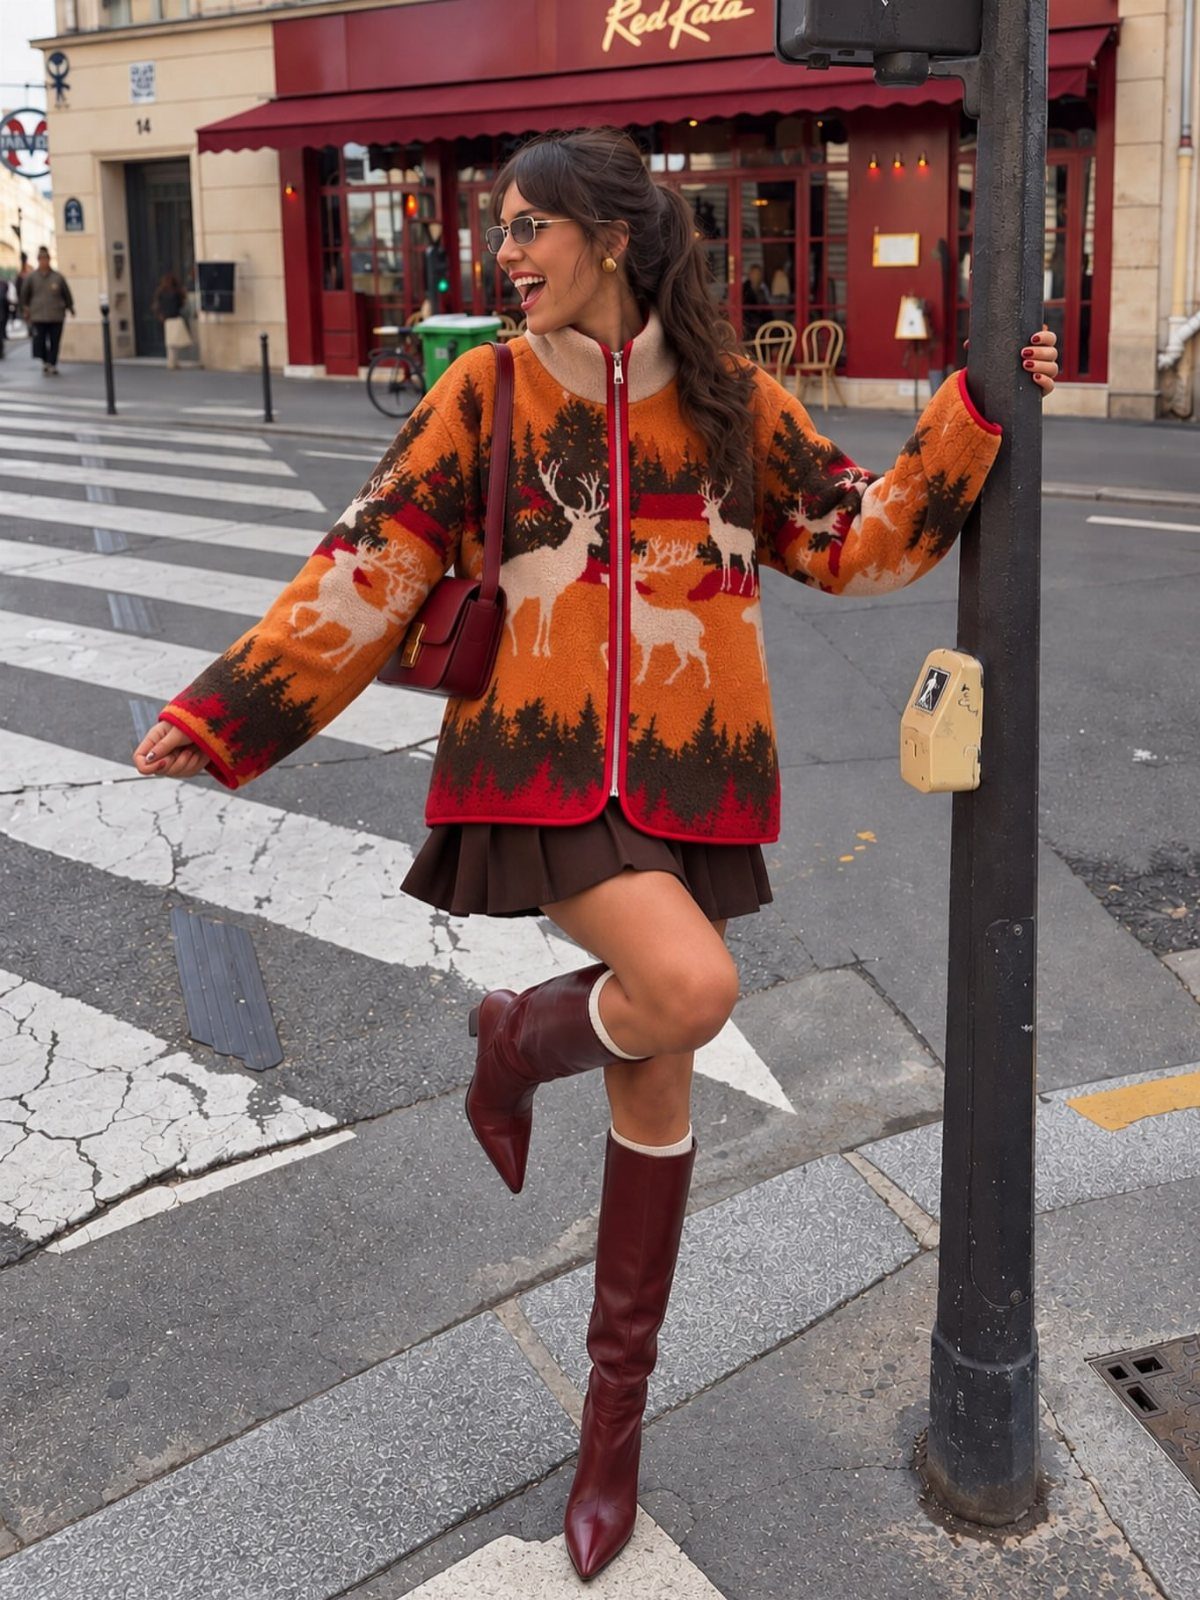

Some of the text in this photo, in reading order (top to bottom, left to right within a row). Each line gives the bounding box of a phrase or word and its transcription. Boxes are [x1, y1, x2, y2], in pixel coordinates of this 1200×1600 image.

[602, 0, 755, 52] Red Kata
[136, 118, 151, 135] 14
